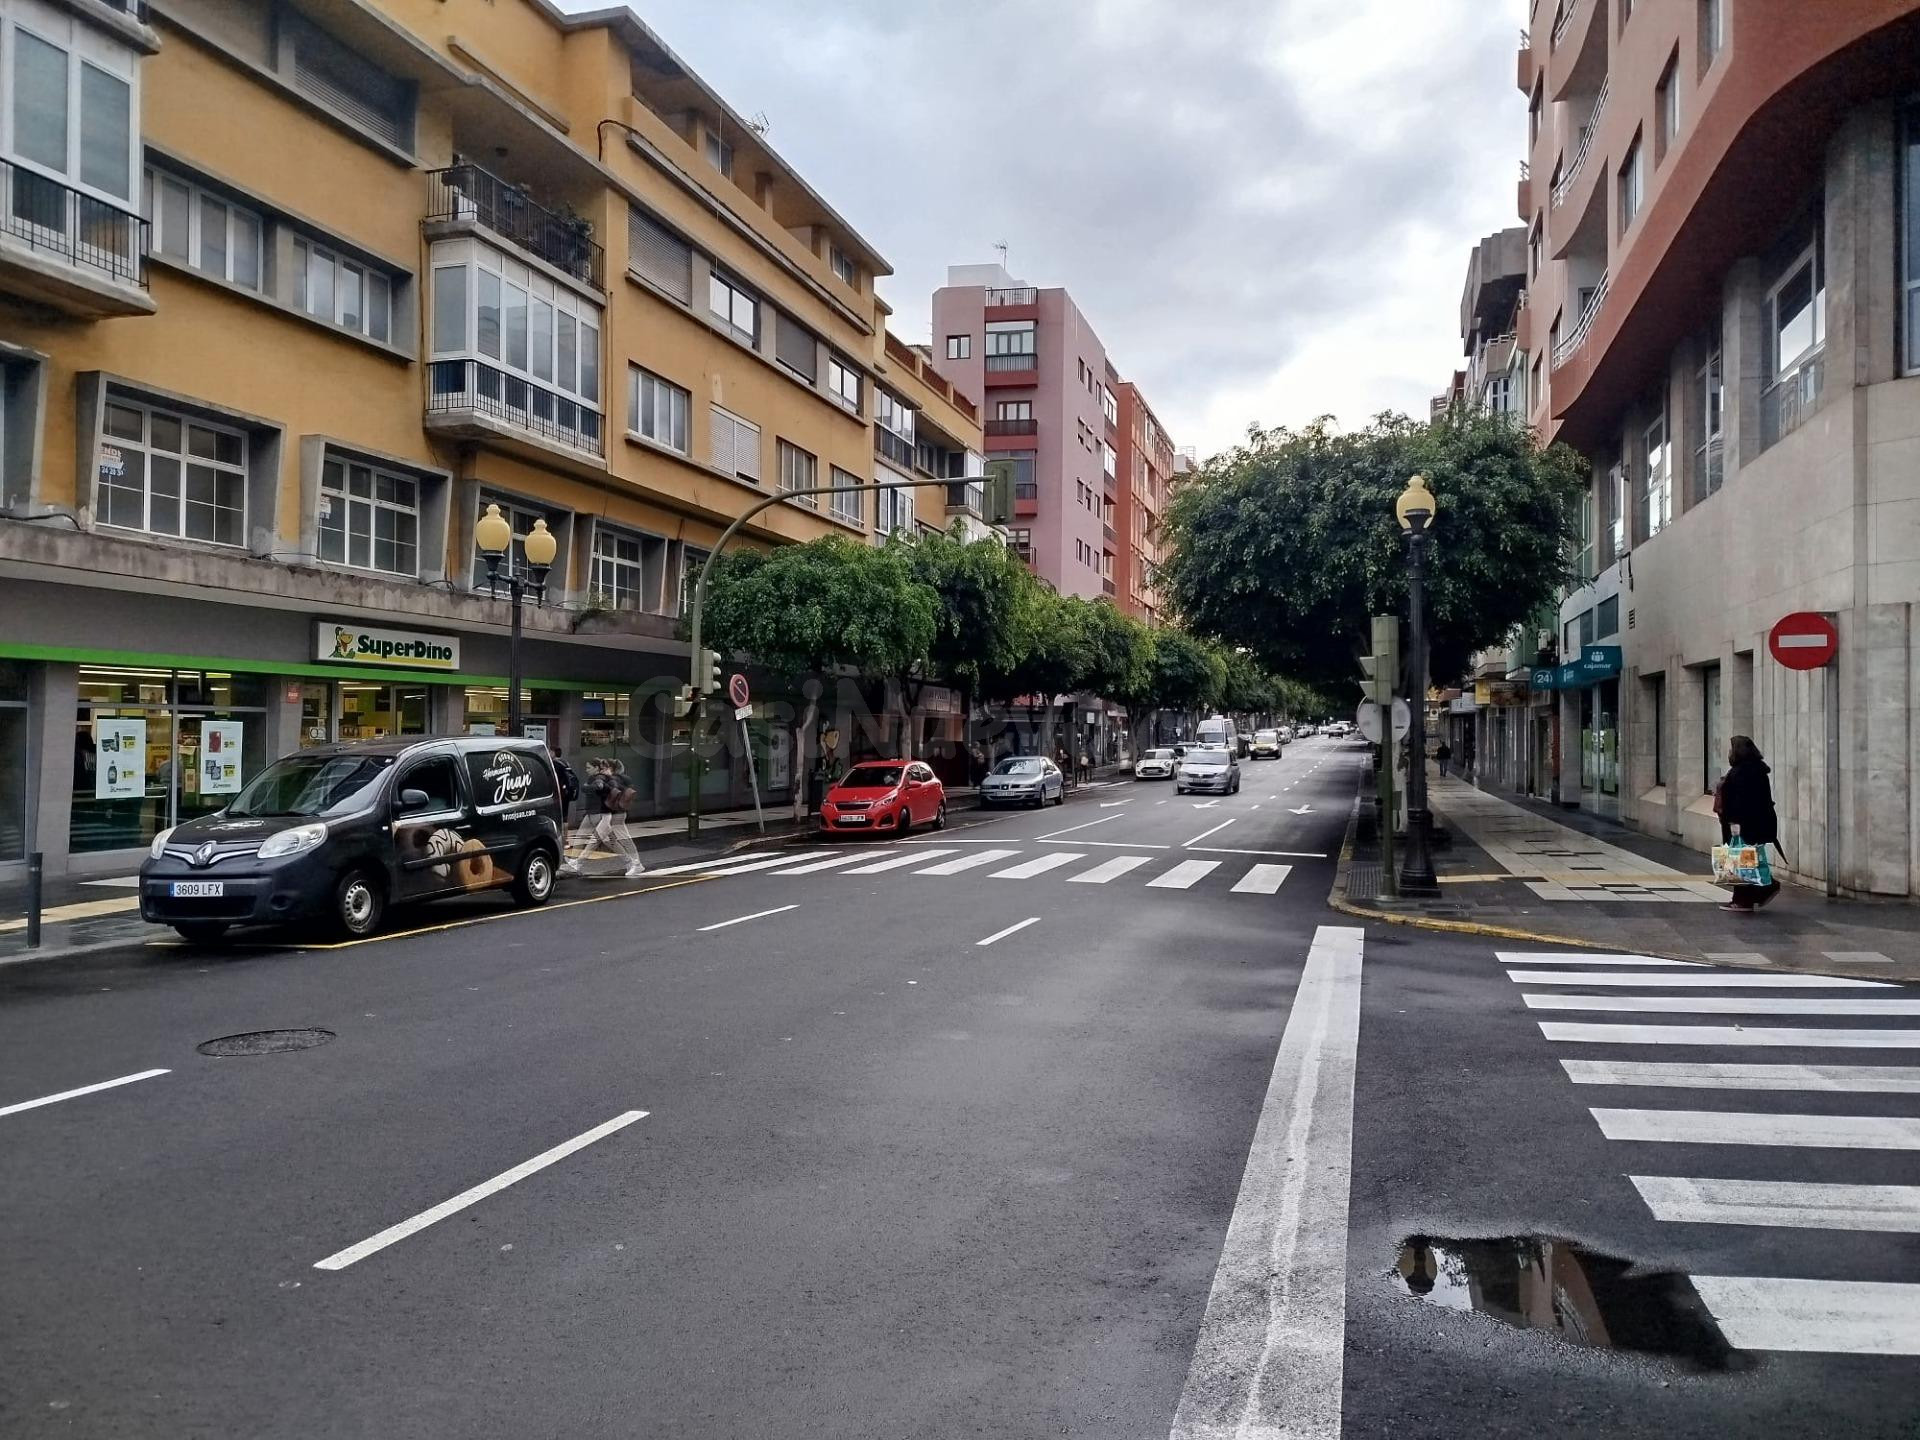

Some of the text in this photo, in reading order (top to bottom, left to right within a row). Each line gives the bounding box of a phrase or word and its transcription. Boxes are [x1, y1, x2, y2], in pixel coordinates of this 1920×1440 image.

[357, 634, 453, 661] SuperDino
[1583, 663, 1612, 671] cajamar
[1536, 674, 1550, 684] 24
[494, 773, 531, 803] Juan
[176, 884, 221, 896] 3609 LFX
